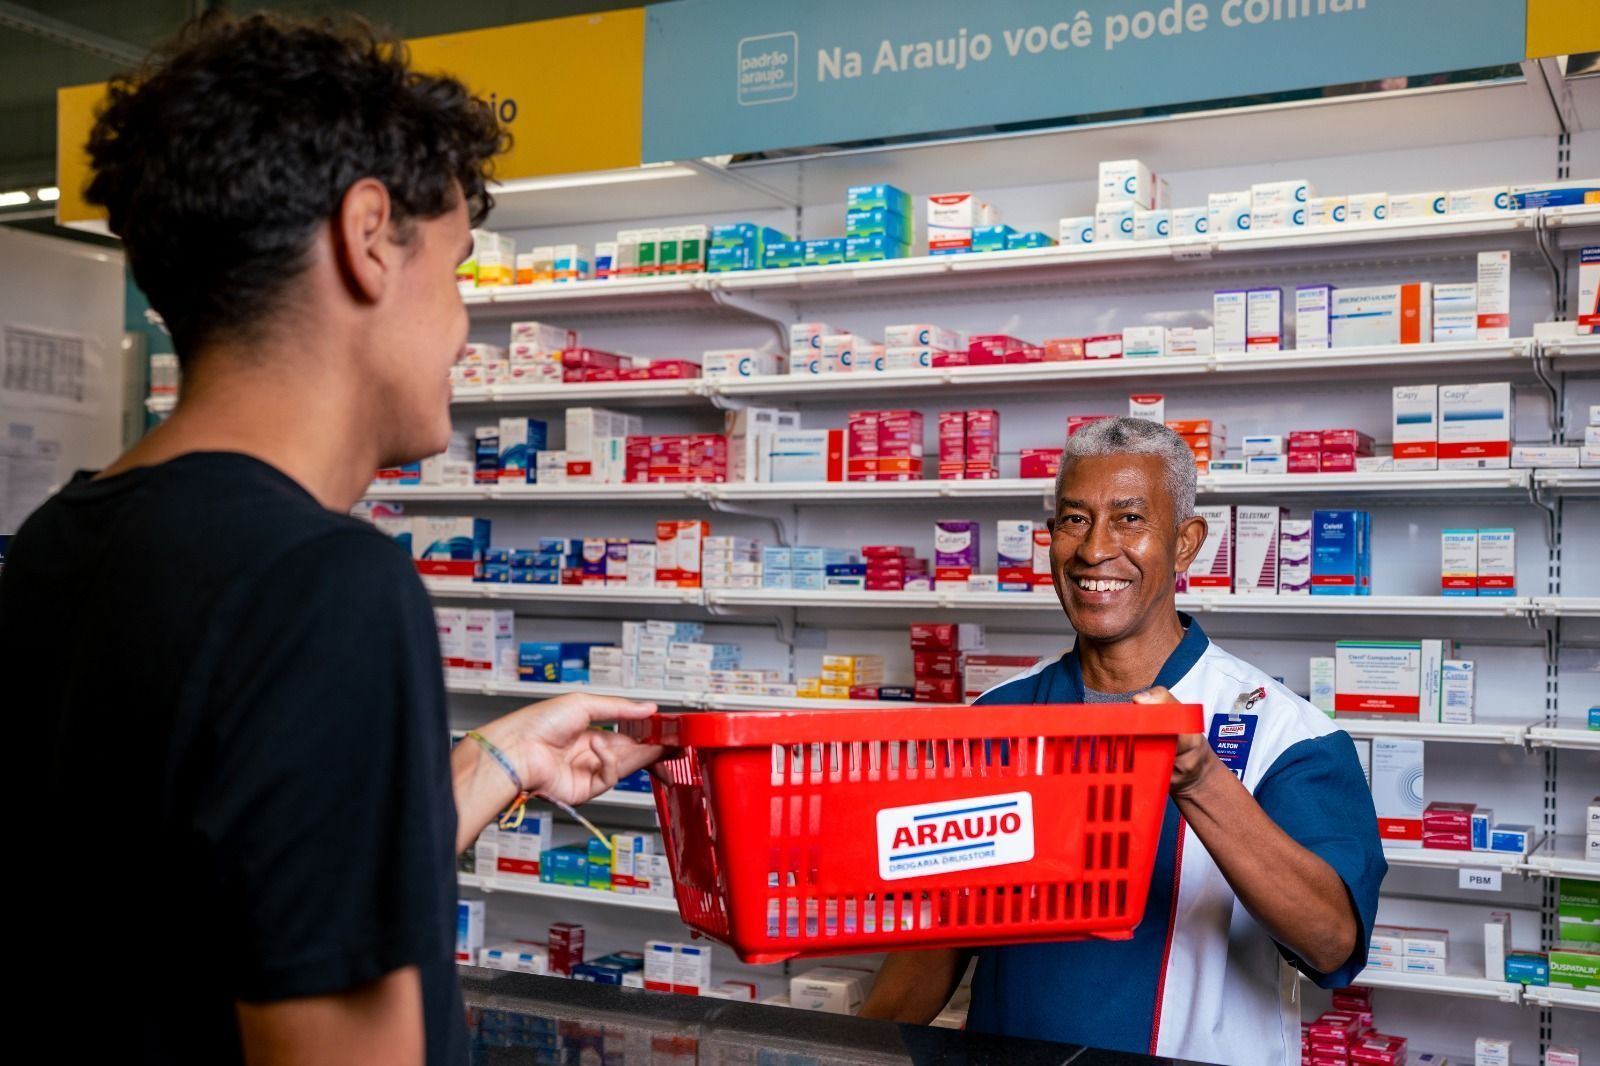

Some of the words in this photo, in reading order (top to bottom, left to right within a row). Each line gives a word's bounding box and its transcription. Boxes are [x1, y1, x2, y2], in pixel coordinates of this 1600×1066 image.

[817, 47, 862, 82] Na
[872, 28, 993, 74] Araujo
[1003, 10, 1093, 57] você
[1104, 0, 1209, 50] pode
[742, 51, 788, 73] padrão
[742, 67, 784, 84] araujo
[891, 812, 1021, 850] ARAUJO
[889, 857, 939, 872] DROGARIA
[942, 849, 996, 864] DRUGSTORE
[1469, 875, 1491, 884] PBM
[1550, 961, 1598, 974] DUSPATALIN
